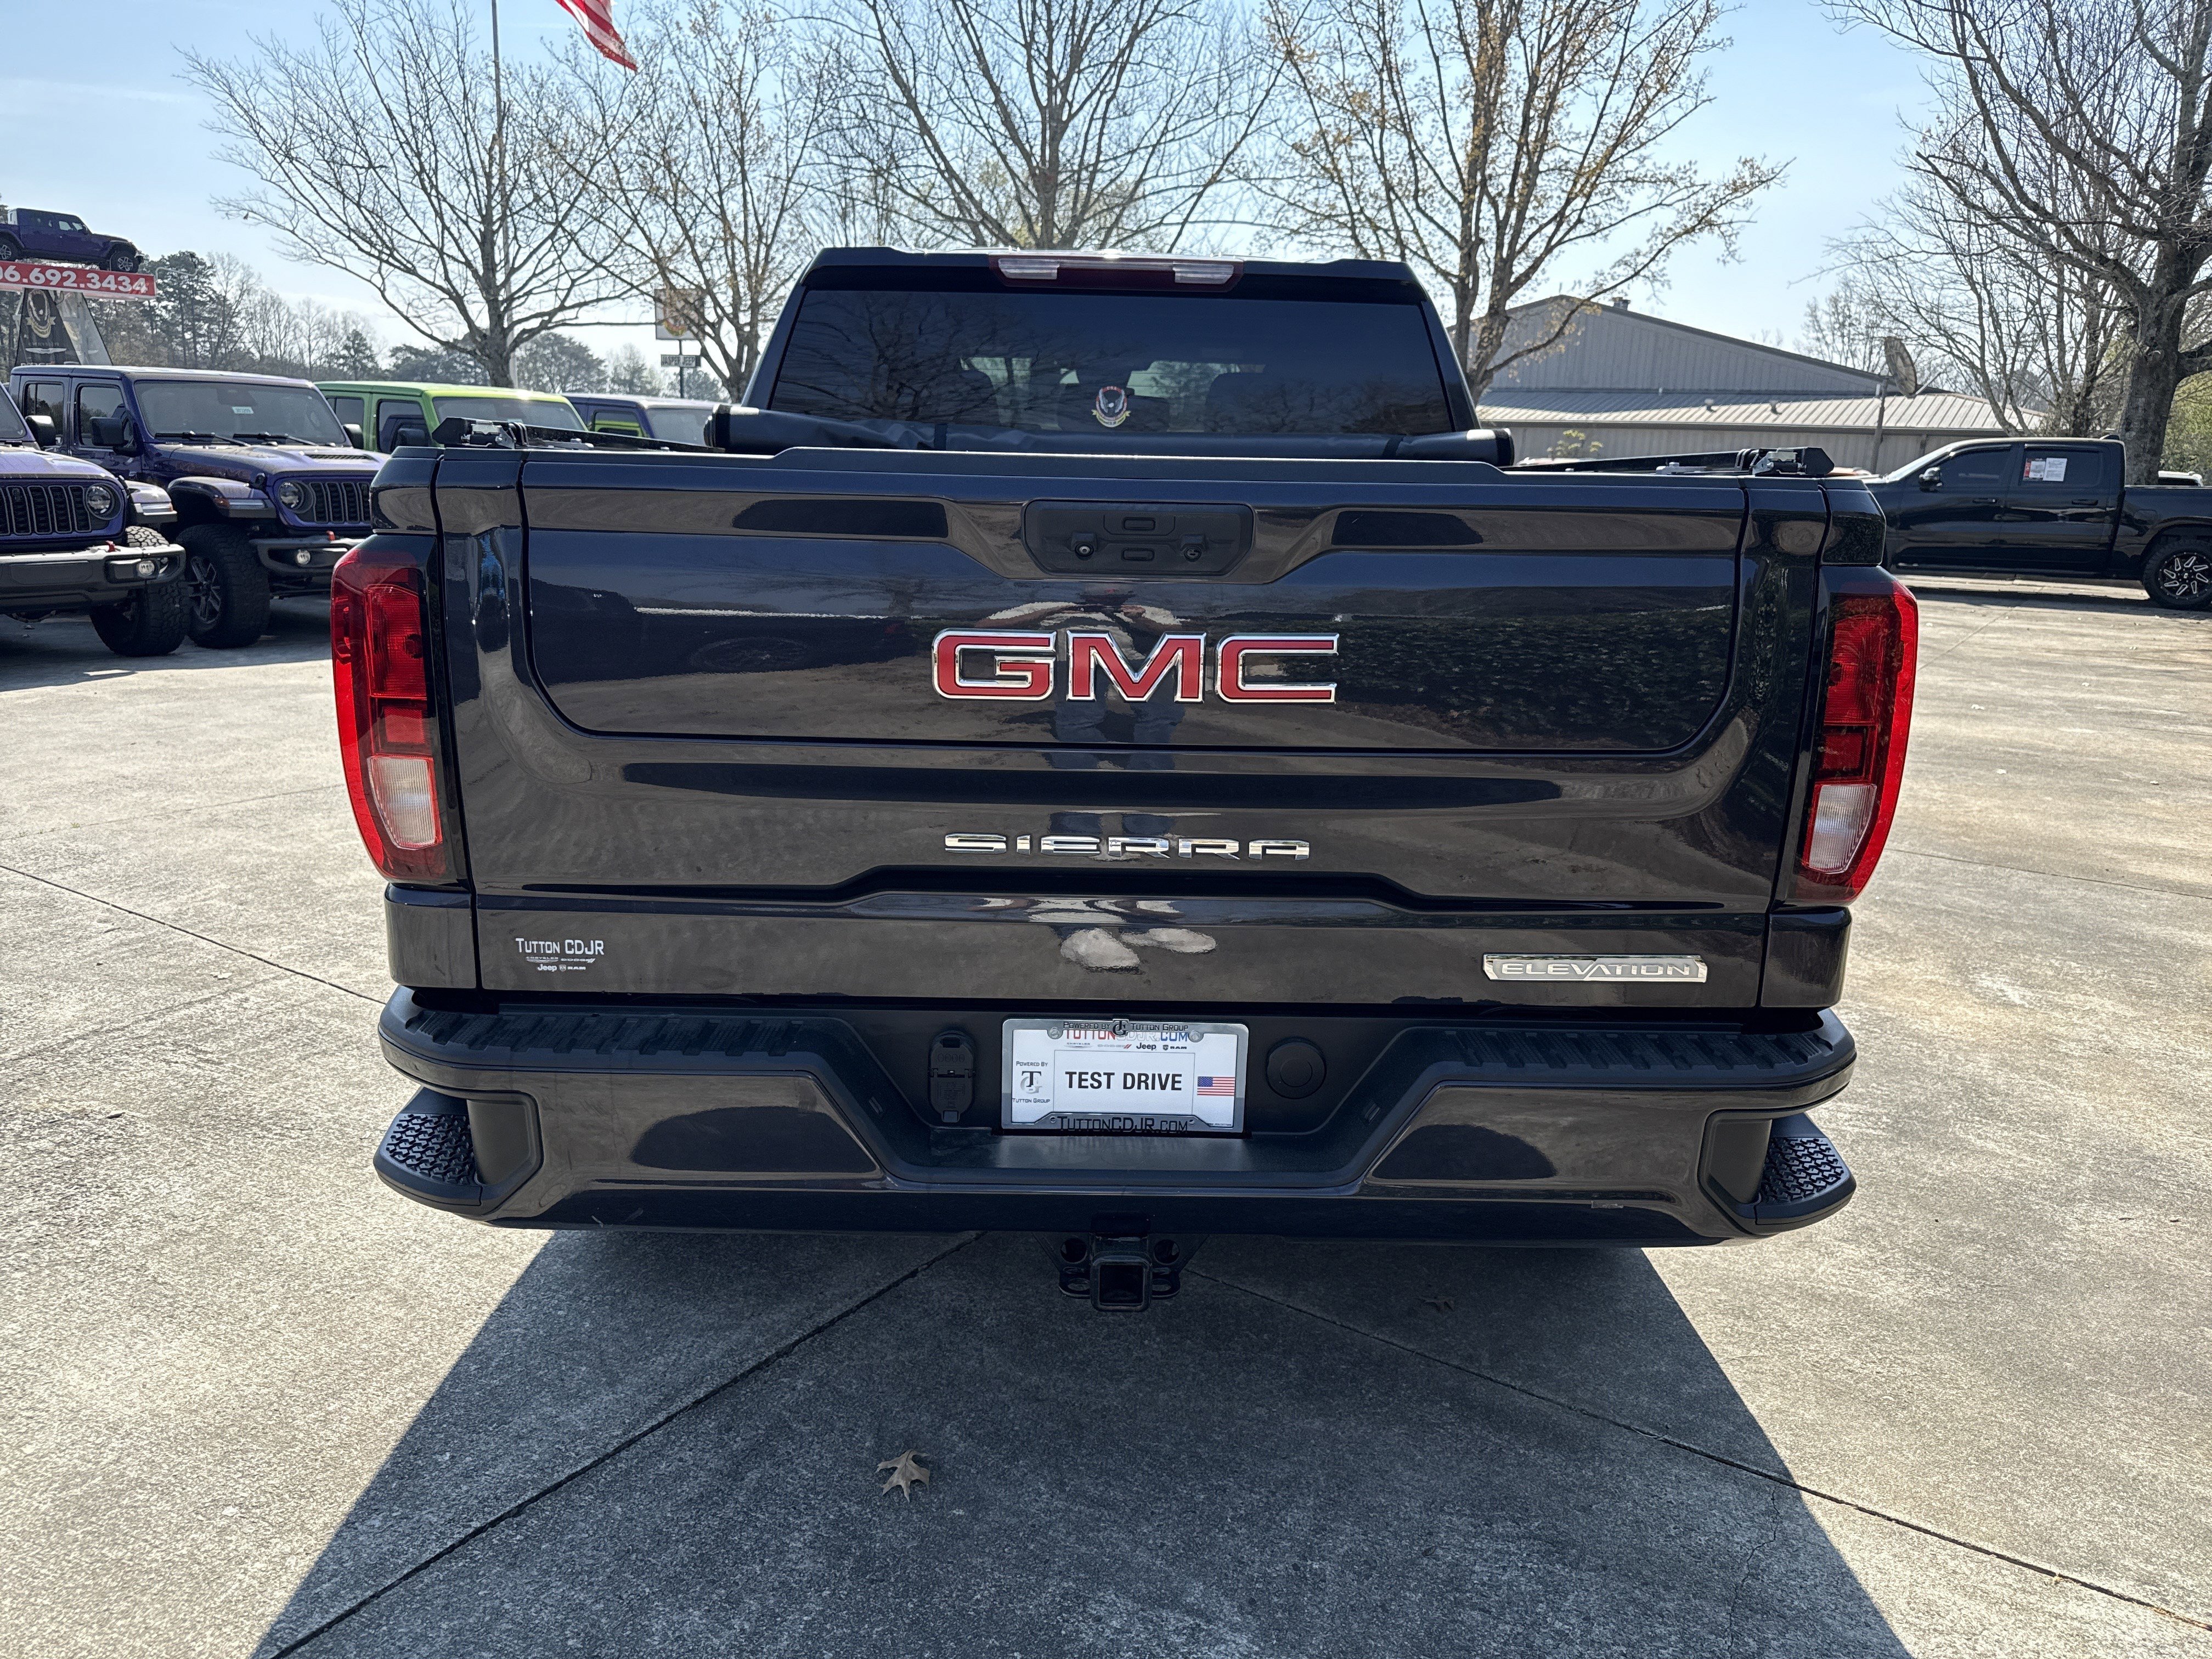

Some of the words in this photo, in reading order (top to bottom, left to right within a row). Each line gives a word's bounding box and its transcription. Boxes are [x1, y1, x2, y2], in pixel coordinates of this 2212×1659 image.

[0, 265, 148, 294] 6.692.3434
[682, 356, 695, 366] JEEP
[932, 628, 1340, 704] GMC
[944, 833, 1311, 861] SIERRA
[516, 938, 560, 953] TUTTON
[565, 939, 605, 955] CDJR
[1502, 963, 1689, 975] ELEVATION
[1136, 1042, 1156, 1051] Jeep
[1065, 1071, 1115, 1090] TEST
[1122, 1072, 1182, 1091] DRIVE
